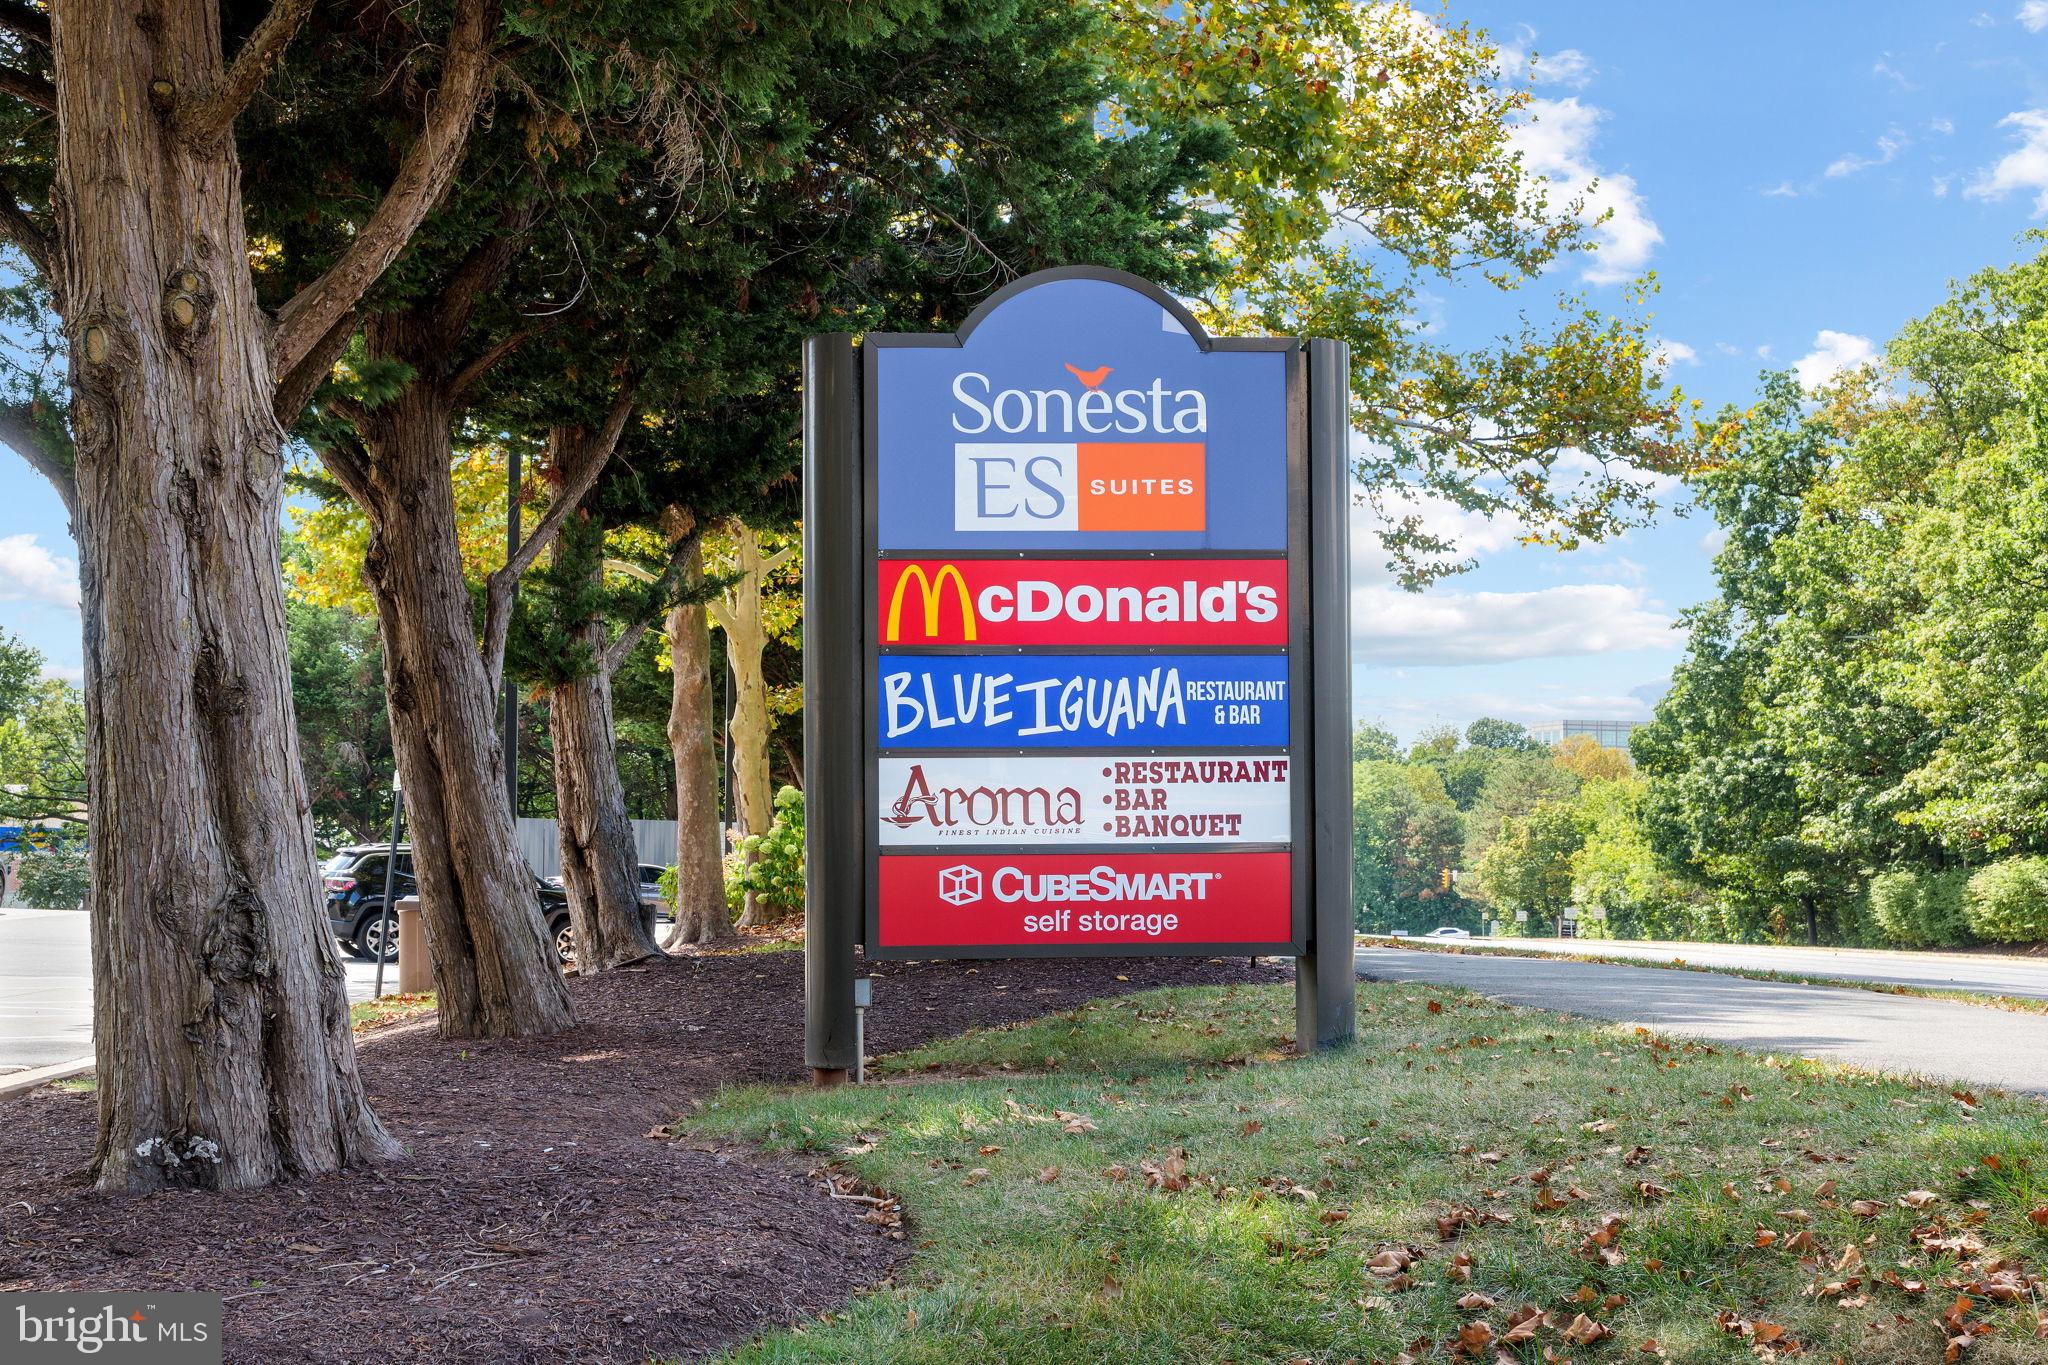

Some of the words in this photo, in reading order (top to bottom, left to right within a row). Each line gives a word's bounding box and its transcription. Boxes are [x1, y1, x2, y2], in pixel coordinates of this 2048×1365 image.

[952, 372, 1207, 434] Sonesta
[969, 456, 1065, 519] ES
[1090, 479, 1194, 495] SUITES
[886, 564, 1279, 642] McDonald's
[883, 671, 1014, 738] BLUE
[1016, 666, 1187, 736] IGUANA
[1186, 680, 1286, 701] RESTAURANT
[1214, 706, 1226, 725] &
[1229, 705, 1261, 725] BAR
[1114, 760, 1288, 784] RESTAURANT
[891, 764, 1085, 828] Aroma
[1114, 788, 1167, 811] BAR
[986, 828, 1027, 836] INDIAN
[1034, 827, 1082, 835] CUISINE
[1114, 814, 1242, 838] BANQUET
[1023, 910, 1071, 932] self
[1079, 910, 1179, 936] storage
